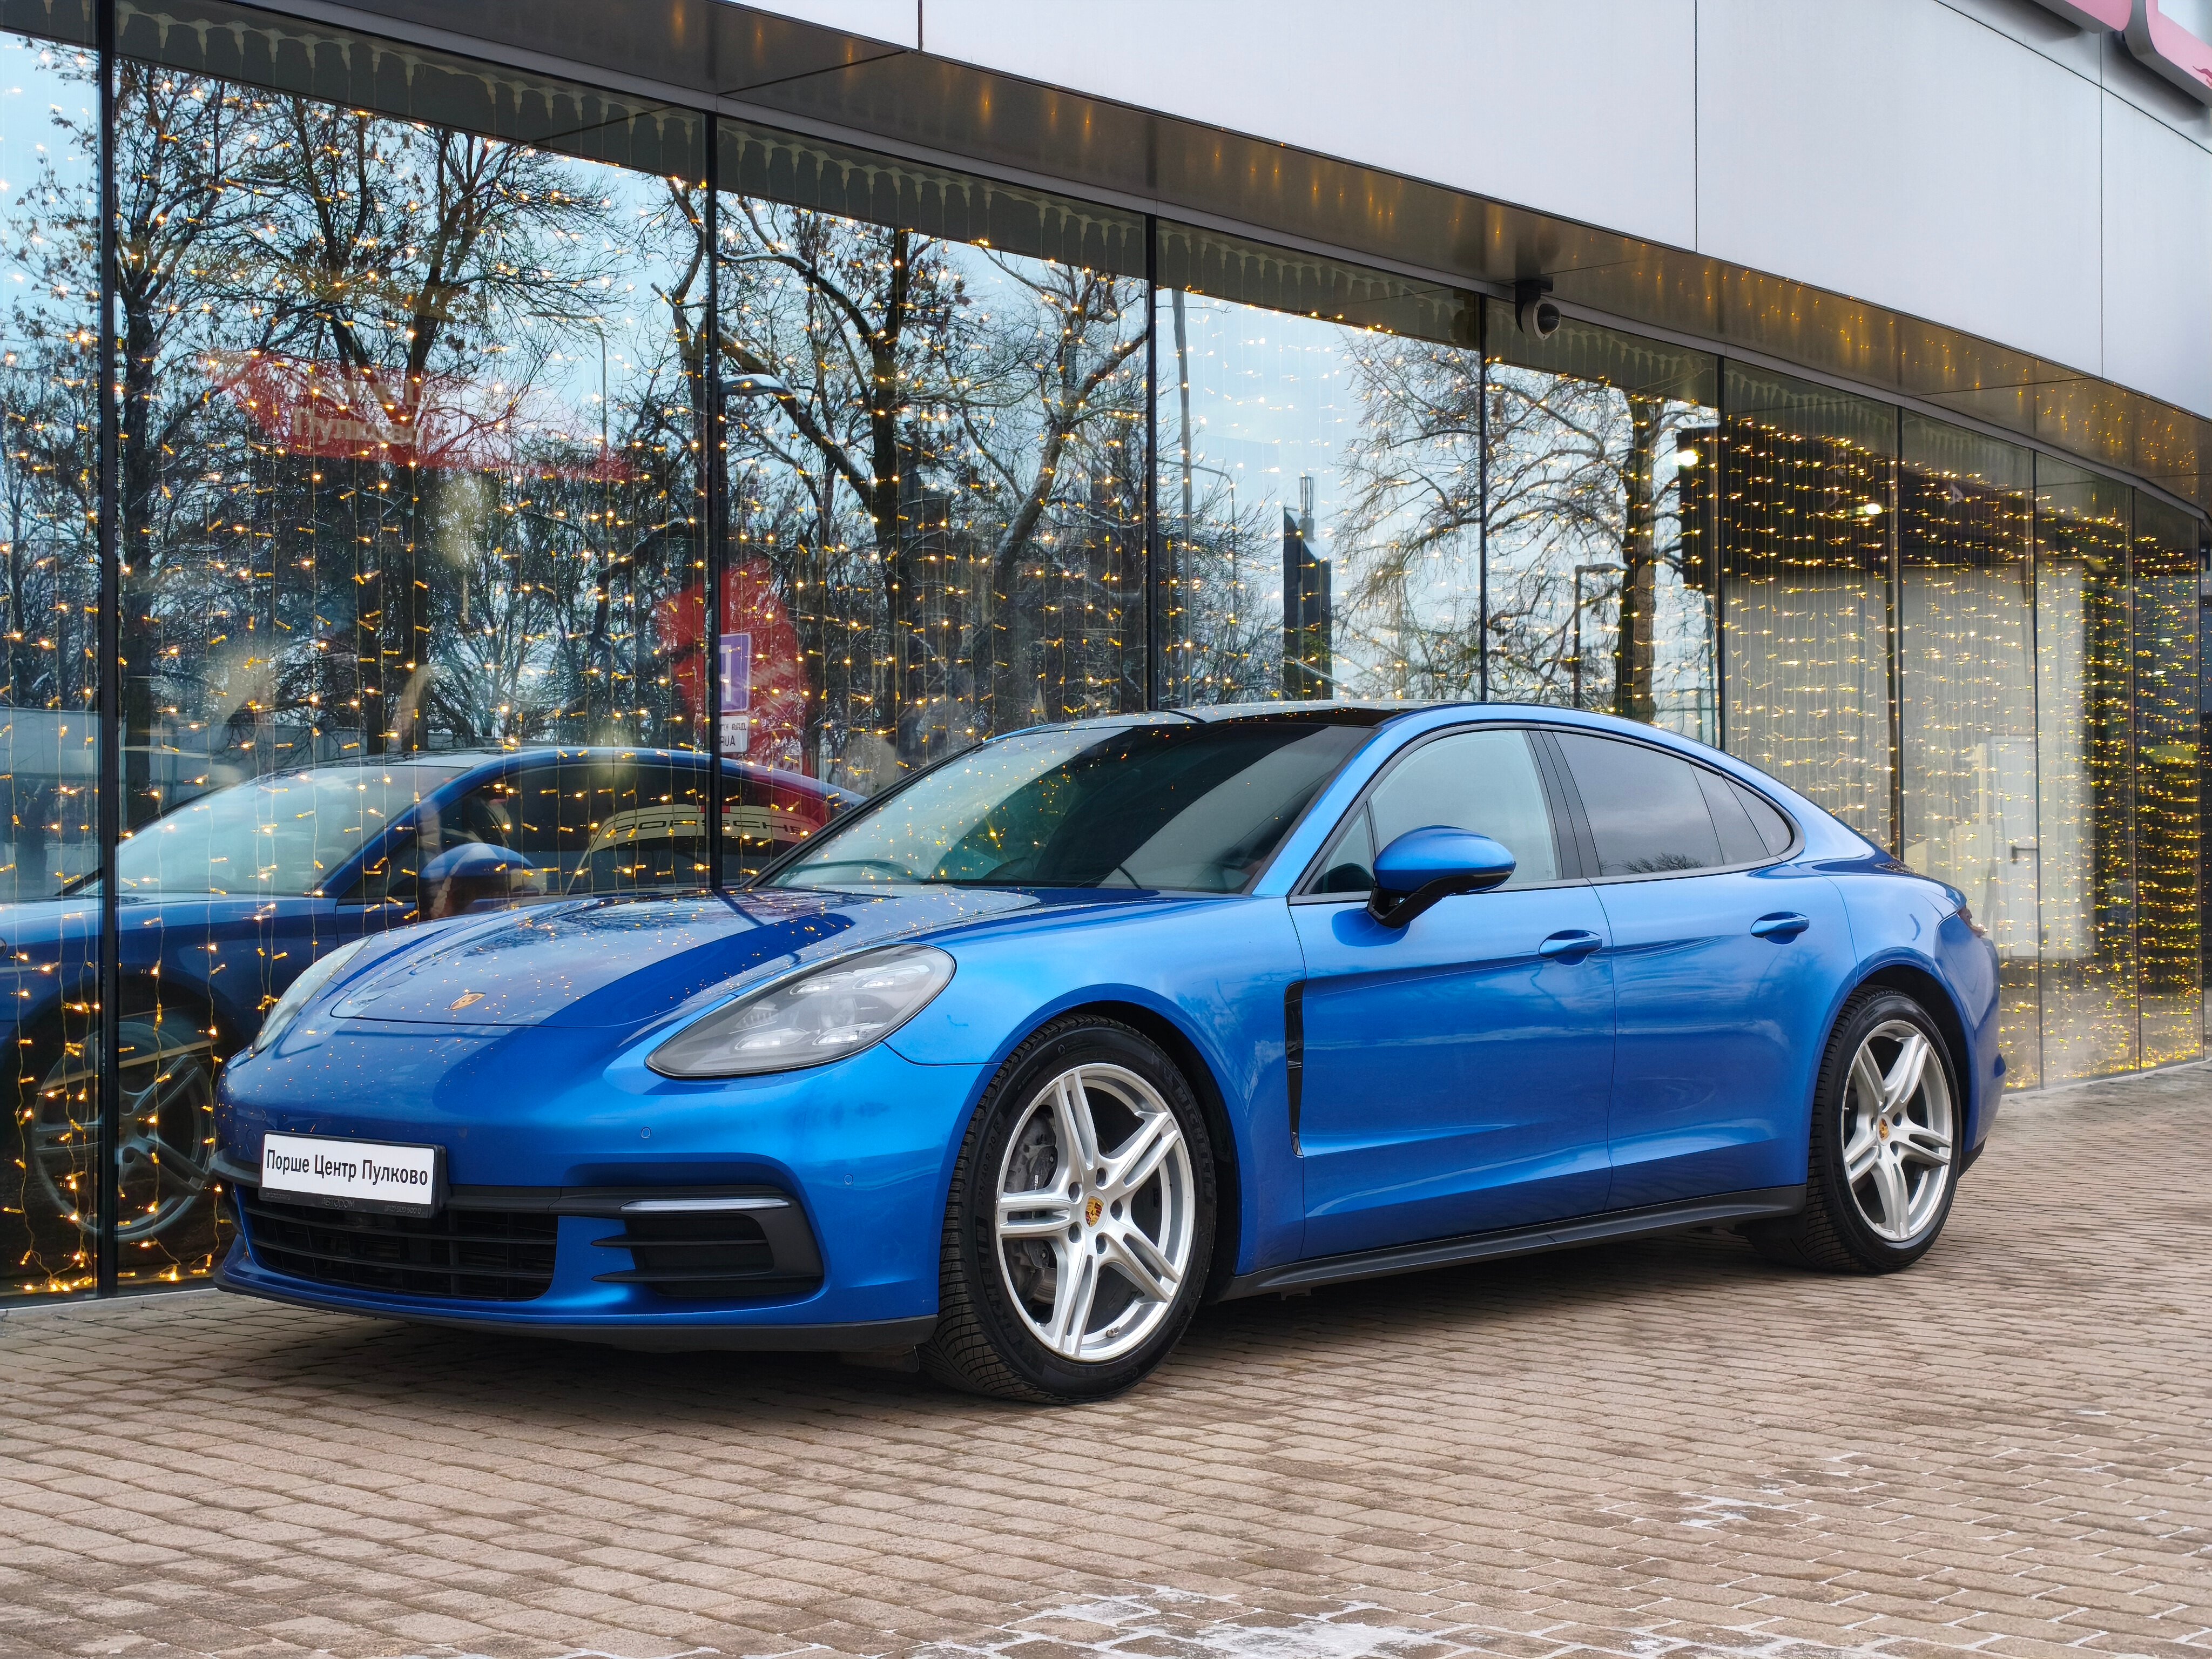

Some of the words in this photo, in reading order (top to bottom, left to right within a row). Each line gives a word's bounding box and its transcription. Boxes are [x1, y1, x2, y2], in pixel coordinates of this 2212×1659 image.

[266, 1149, 309, 1175] Порше
[314, 1154, 357, 1182] Центр
[362, 1159, 428, 1185] Пулково
